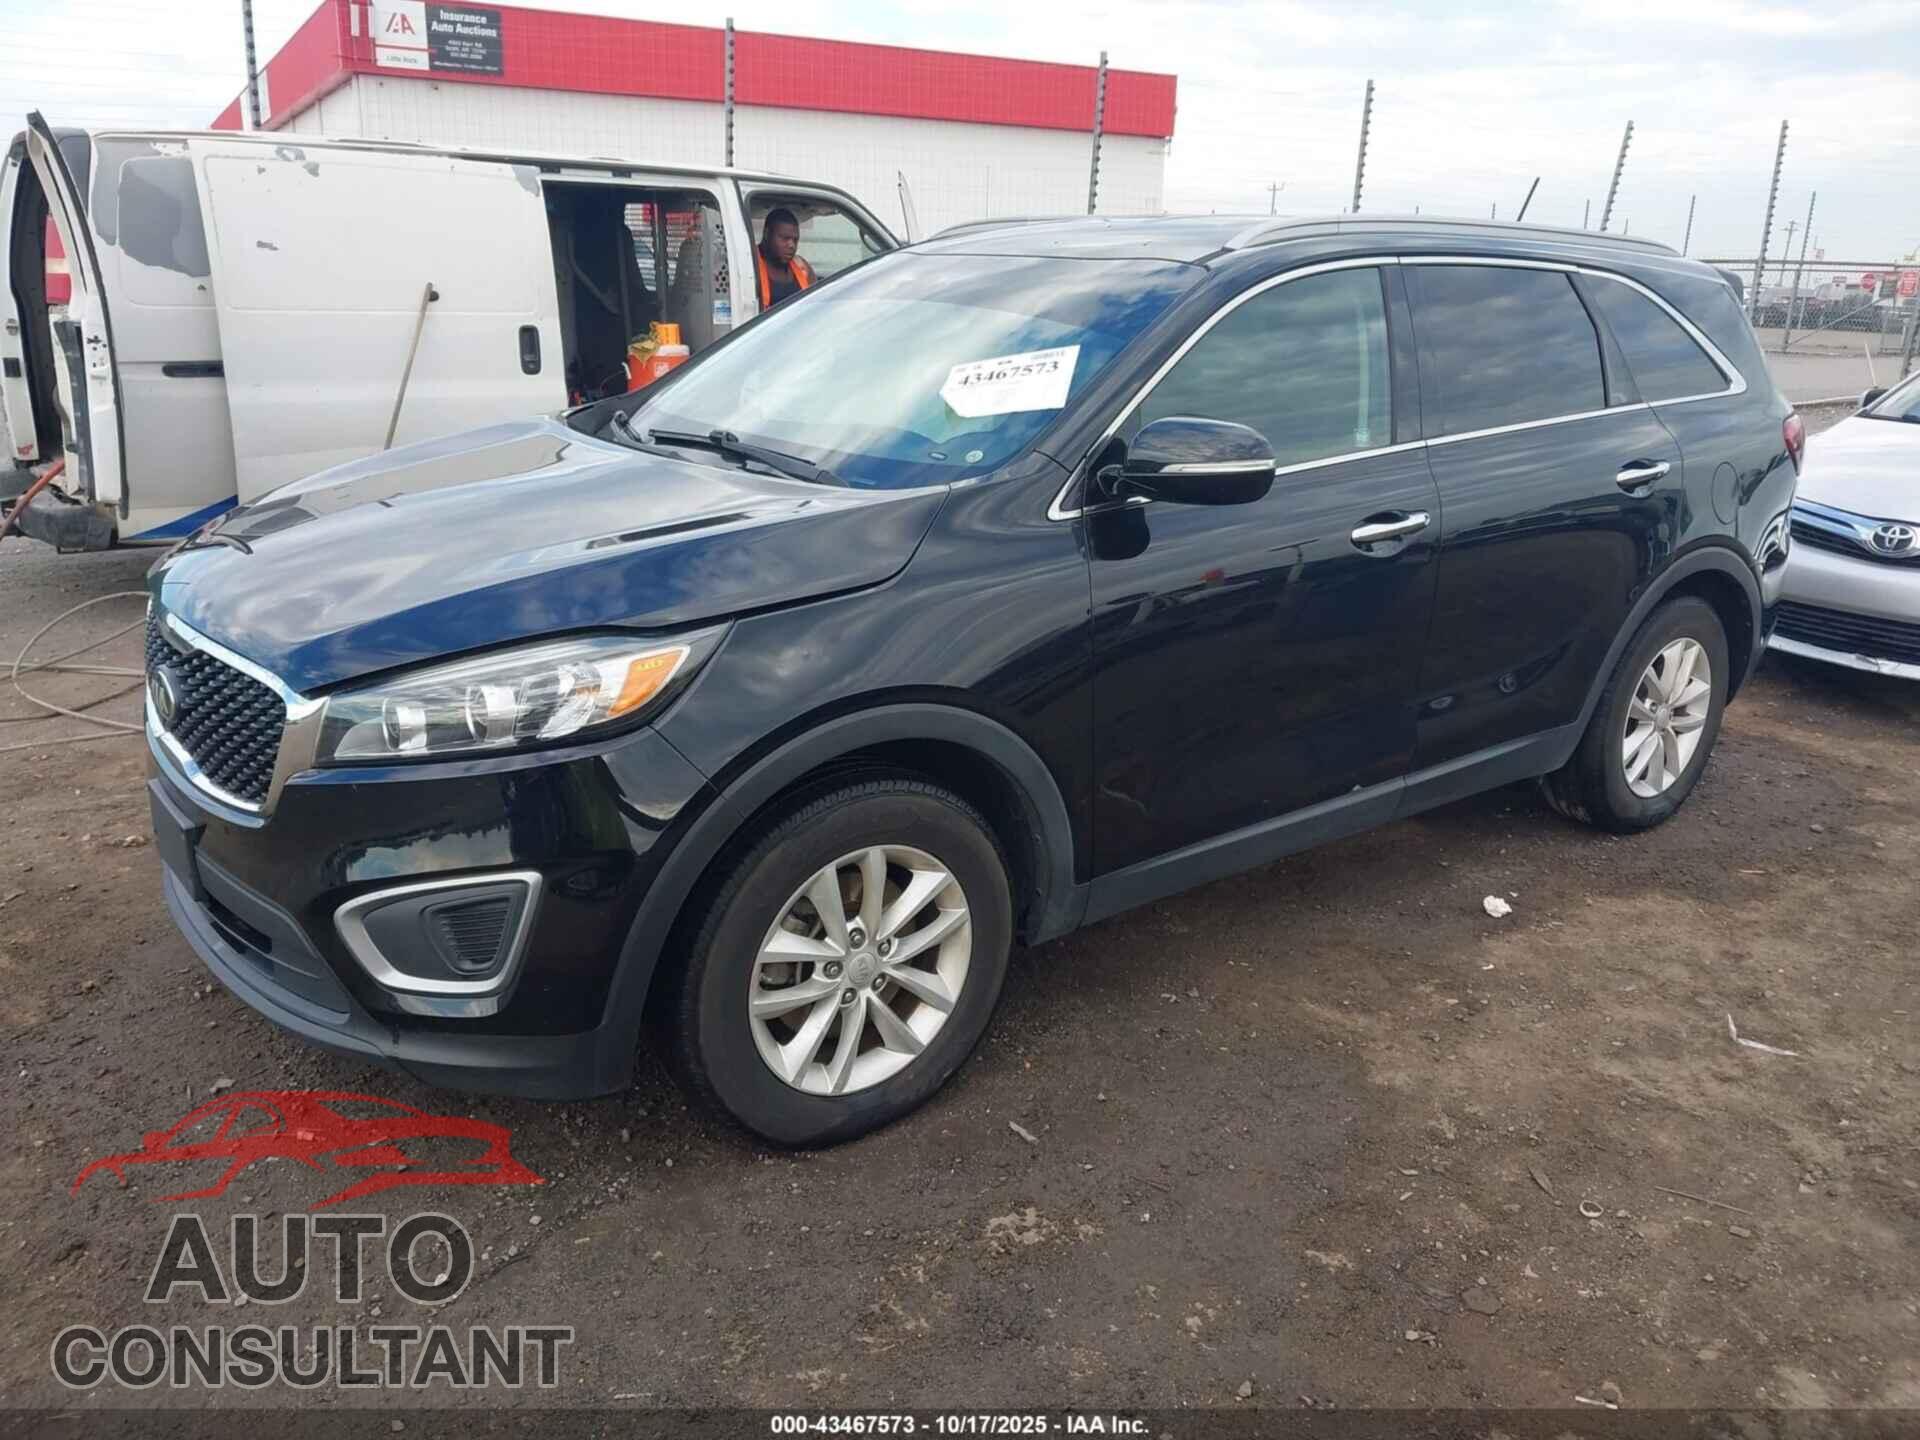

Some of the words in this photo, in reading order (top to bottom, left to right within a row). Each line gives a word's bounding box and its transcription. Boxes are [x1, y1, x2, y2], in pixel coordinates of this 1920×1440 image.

[439, 9, 488, 24] Insurance
[431, 21, 453, 33] Auto
[455, 22, 497, 37] Auctions
[958, 361, 1060, 386] 43467573
